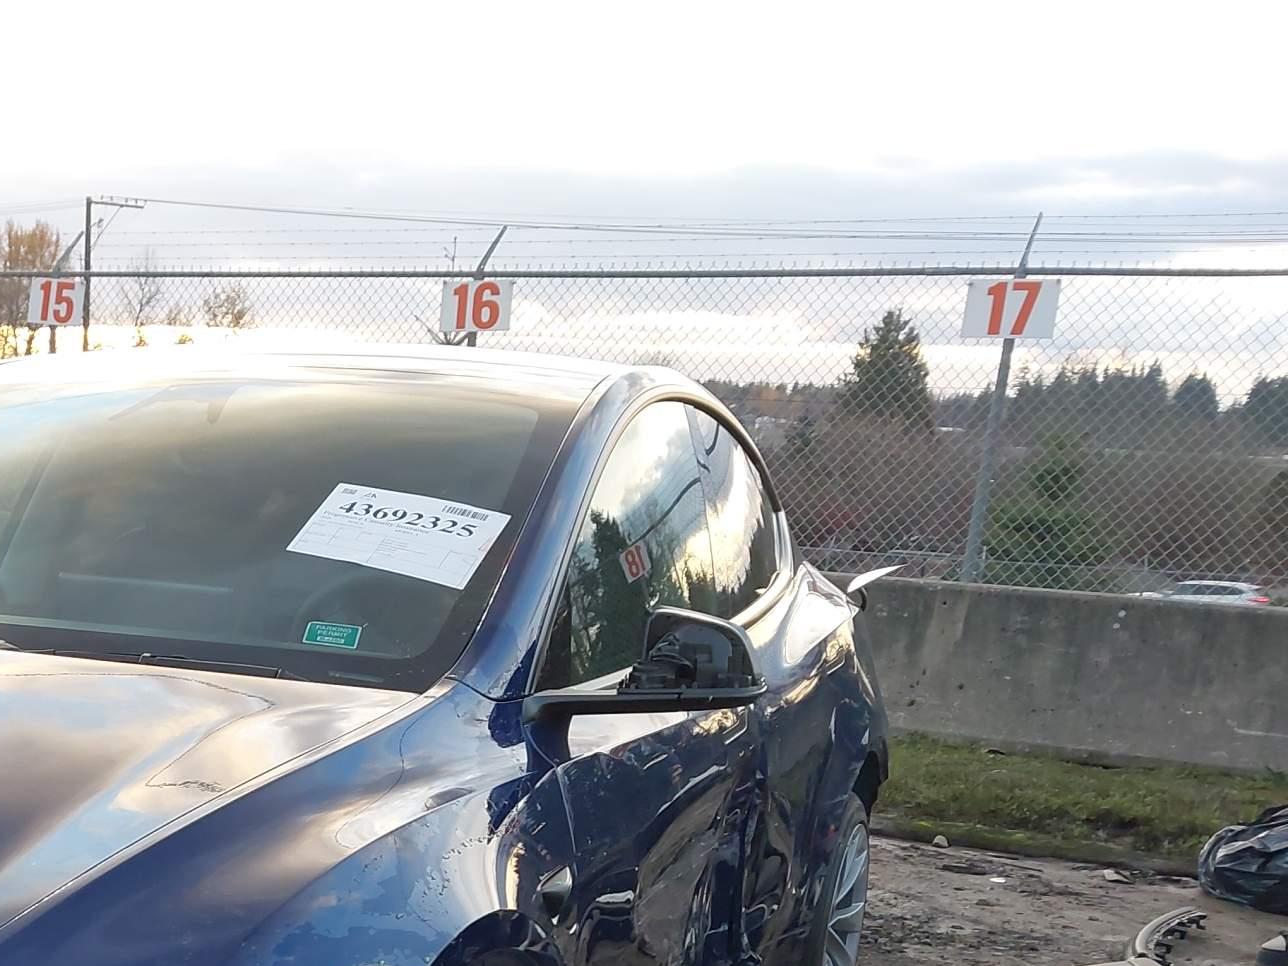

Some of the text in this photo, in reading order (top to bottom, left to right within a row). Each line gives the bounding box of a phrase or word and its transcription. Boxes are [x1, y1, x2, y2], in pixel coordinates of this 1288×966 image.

[40, 280, 75, 323] 15
[453, 282, 500, 329] 16
[987, 282, 1042, 335] 17
[338, 501, 478, 538] 43692325
